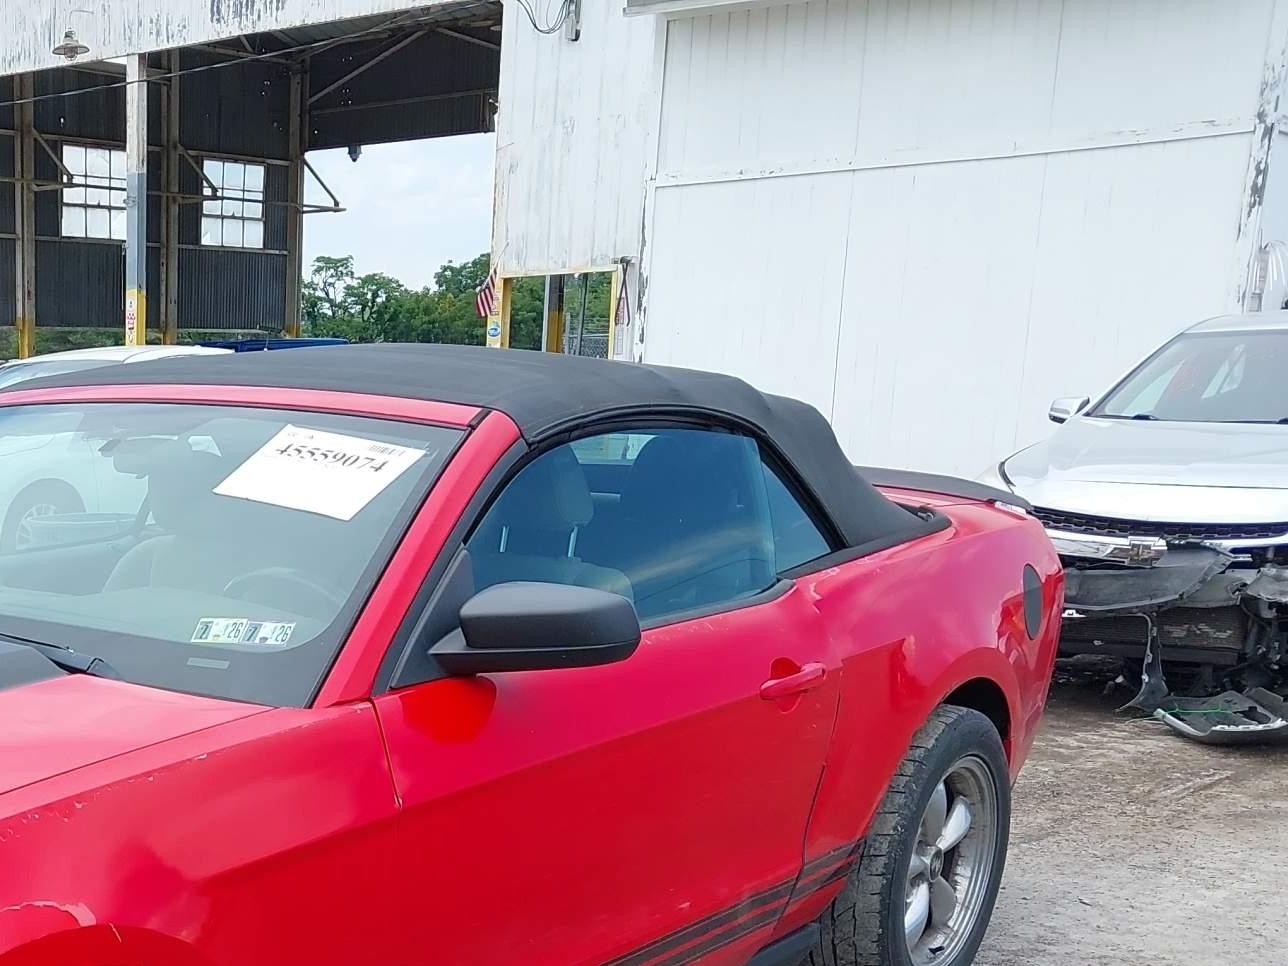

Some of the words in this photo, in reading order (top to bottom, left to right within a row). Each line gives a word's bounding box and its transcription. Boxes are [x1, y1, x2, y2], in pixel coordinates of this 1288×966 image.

[275, 443, 390, 472] 45559074
[227, 622, 244, 639] 26
[246, 626, 258, 642] 7
[275, 625, 292, 642] 26
